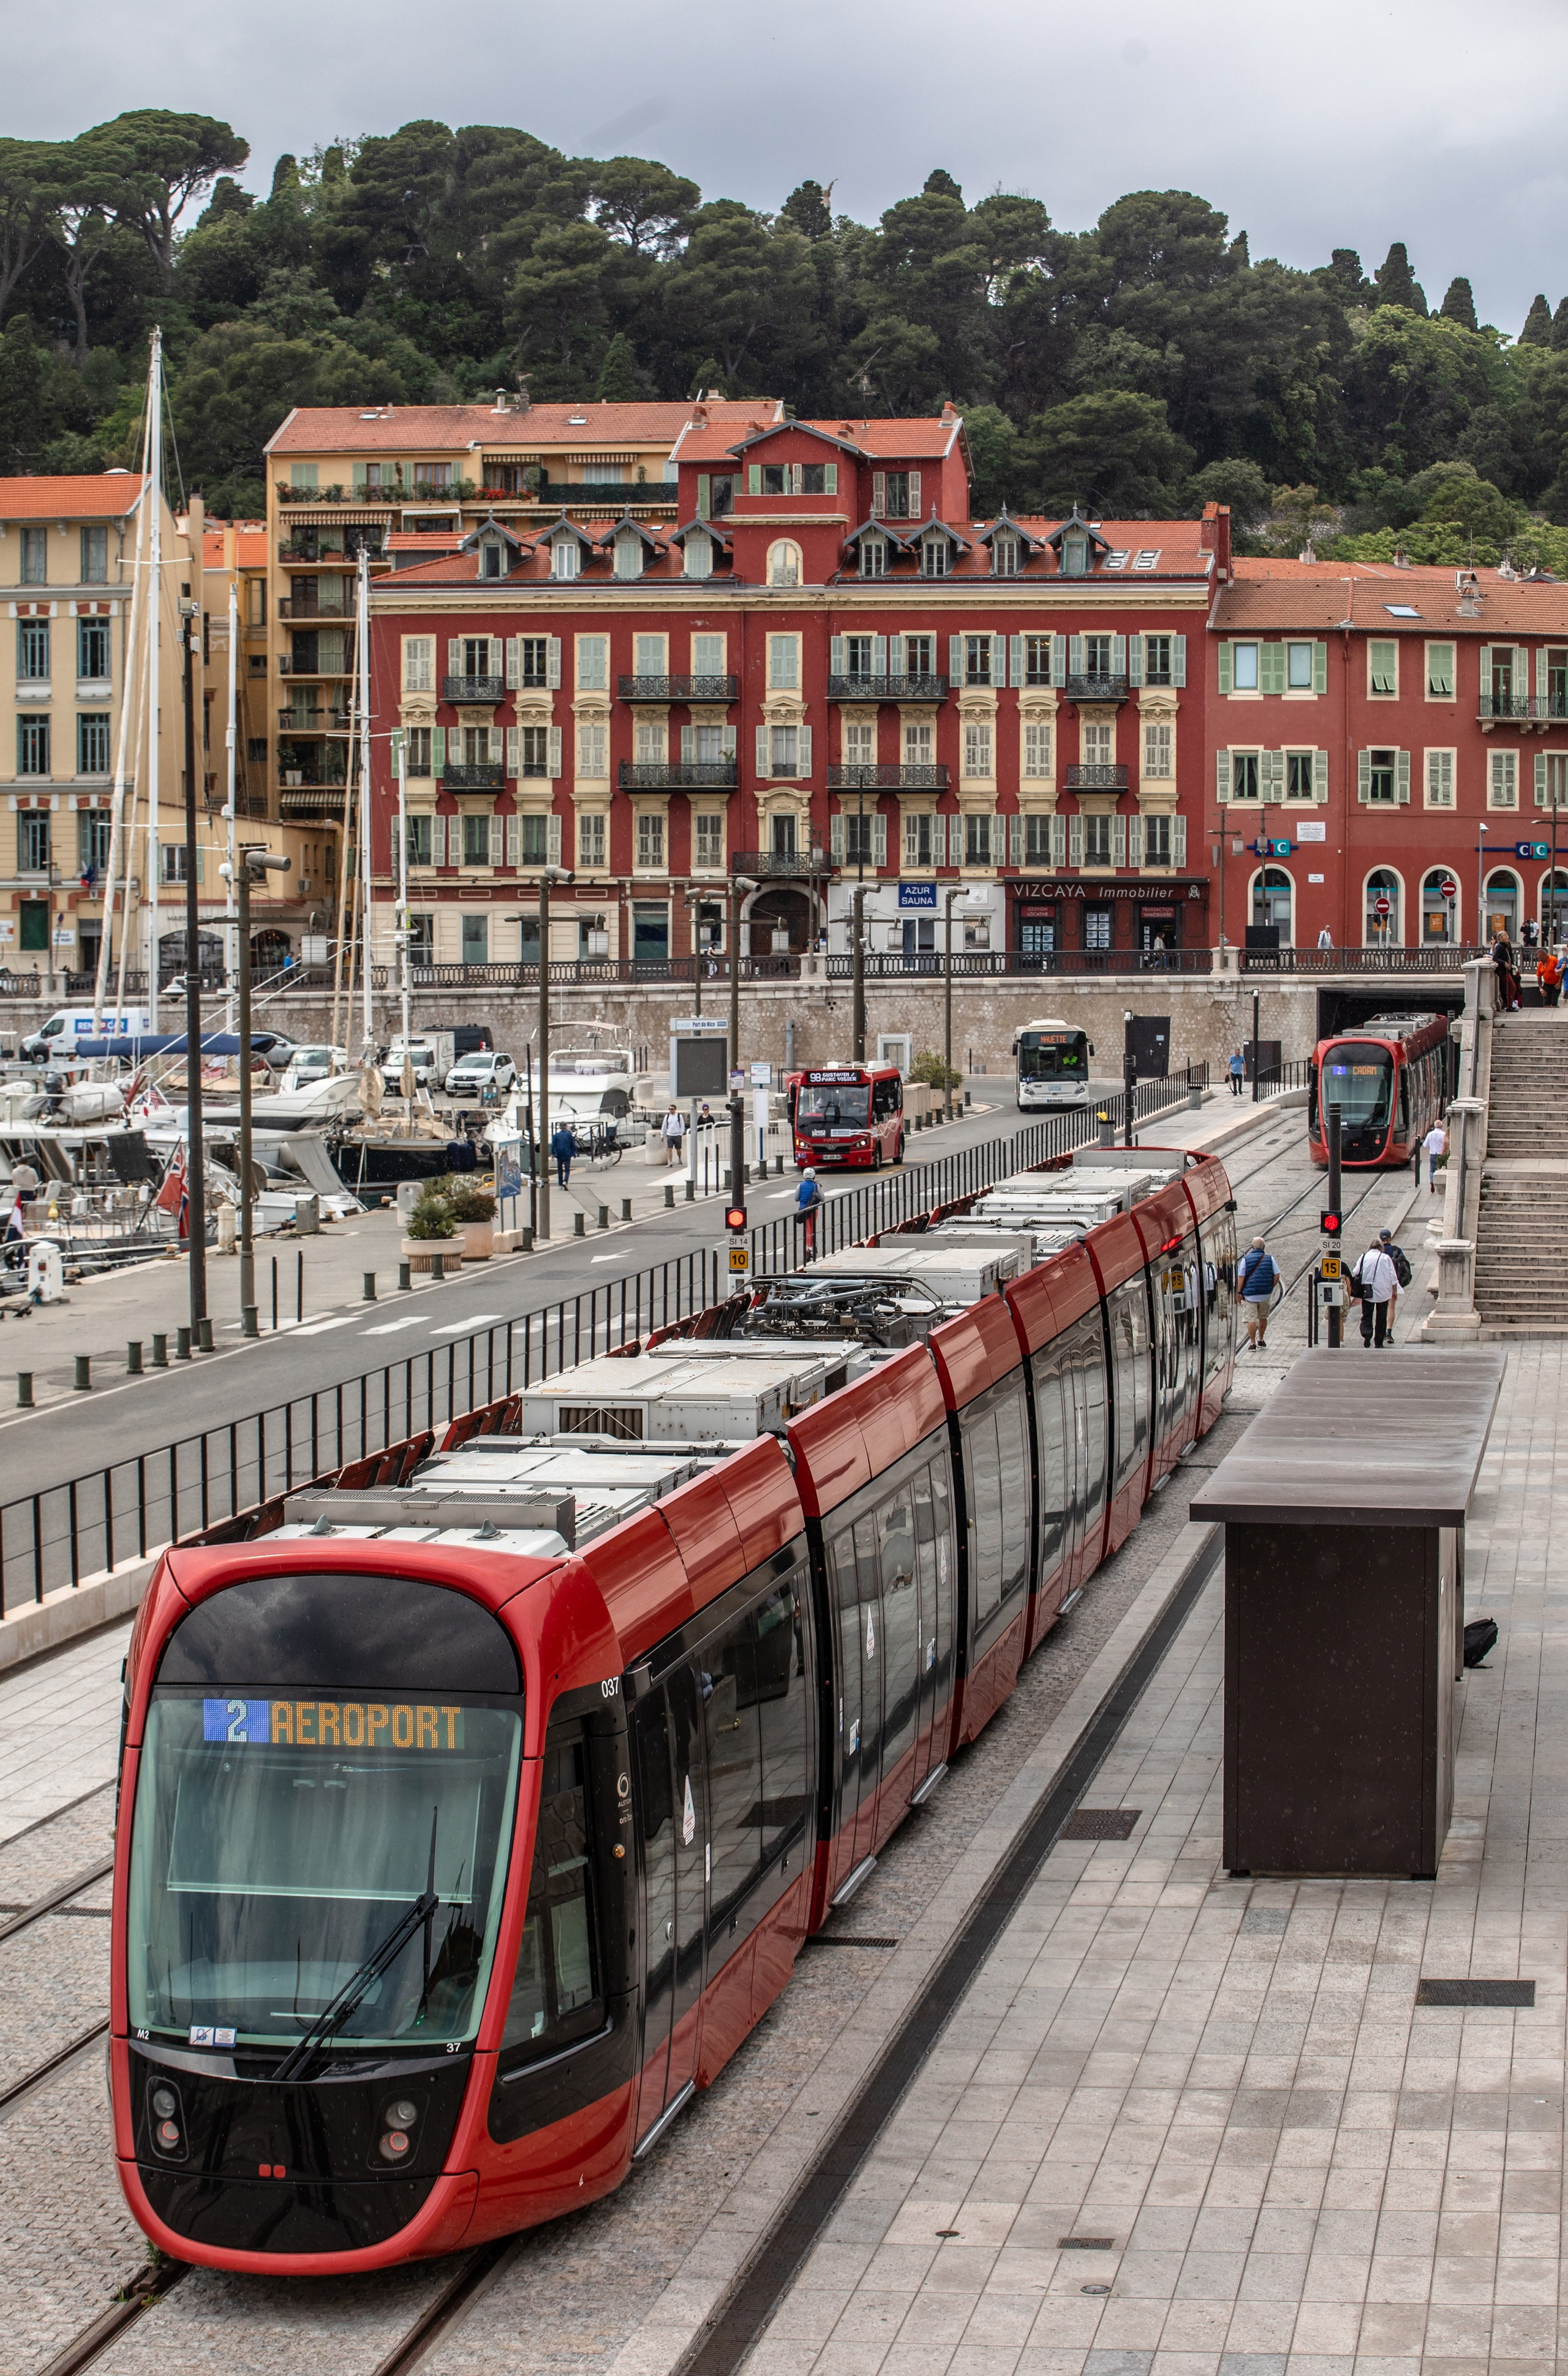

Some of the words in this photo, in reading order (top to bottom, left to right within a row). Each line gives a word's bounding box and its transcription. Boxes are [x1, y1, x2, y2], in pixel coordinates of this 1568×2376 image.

[1519, 845, 1545, 856] CIC
[1014, 884, 1085, 898] VIZCAYA
[1099, 887, 1174, 898] Immobilier
[1352, 1067, 1377, 1075] CADAM
[810, 1073, 821, 1082] 98
[732, 1254, 745, 1265] 10
[1325, 1263, 1336, 1274] 15
[601, 1676, 619, 1698] 037
[227, 1700, 246, 1742] 2
[272, 1701, 461, 1749] AEROPORT
[618, 1798, 631, 1808] ALSTOM
[137, 2028, 149, 2040] M2
[447, 2042, 461, 2053] 37
